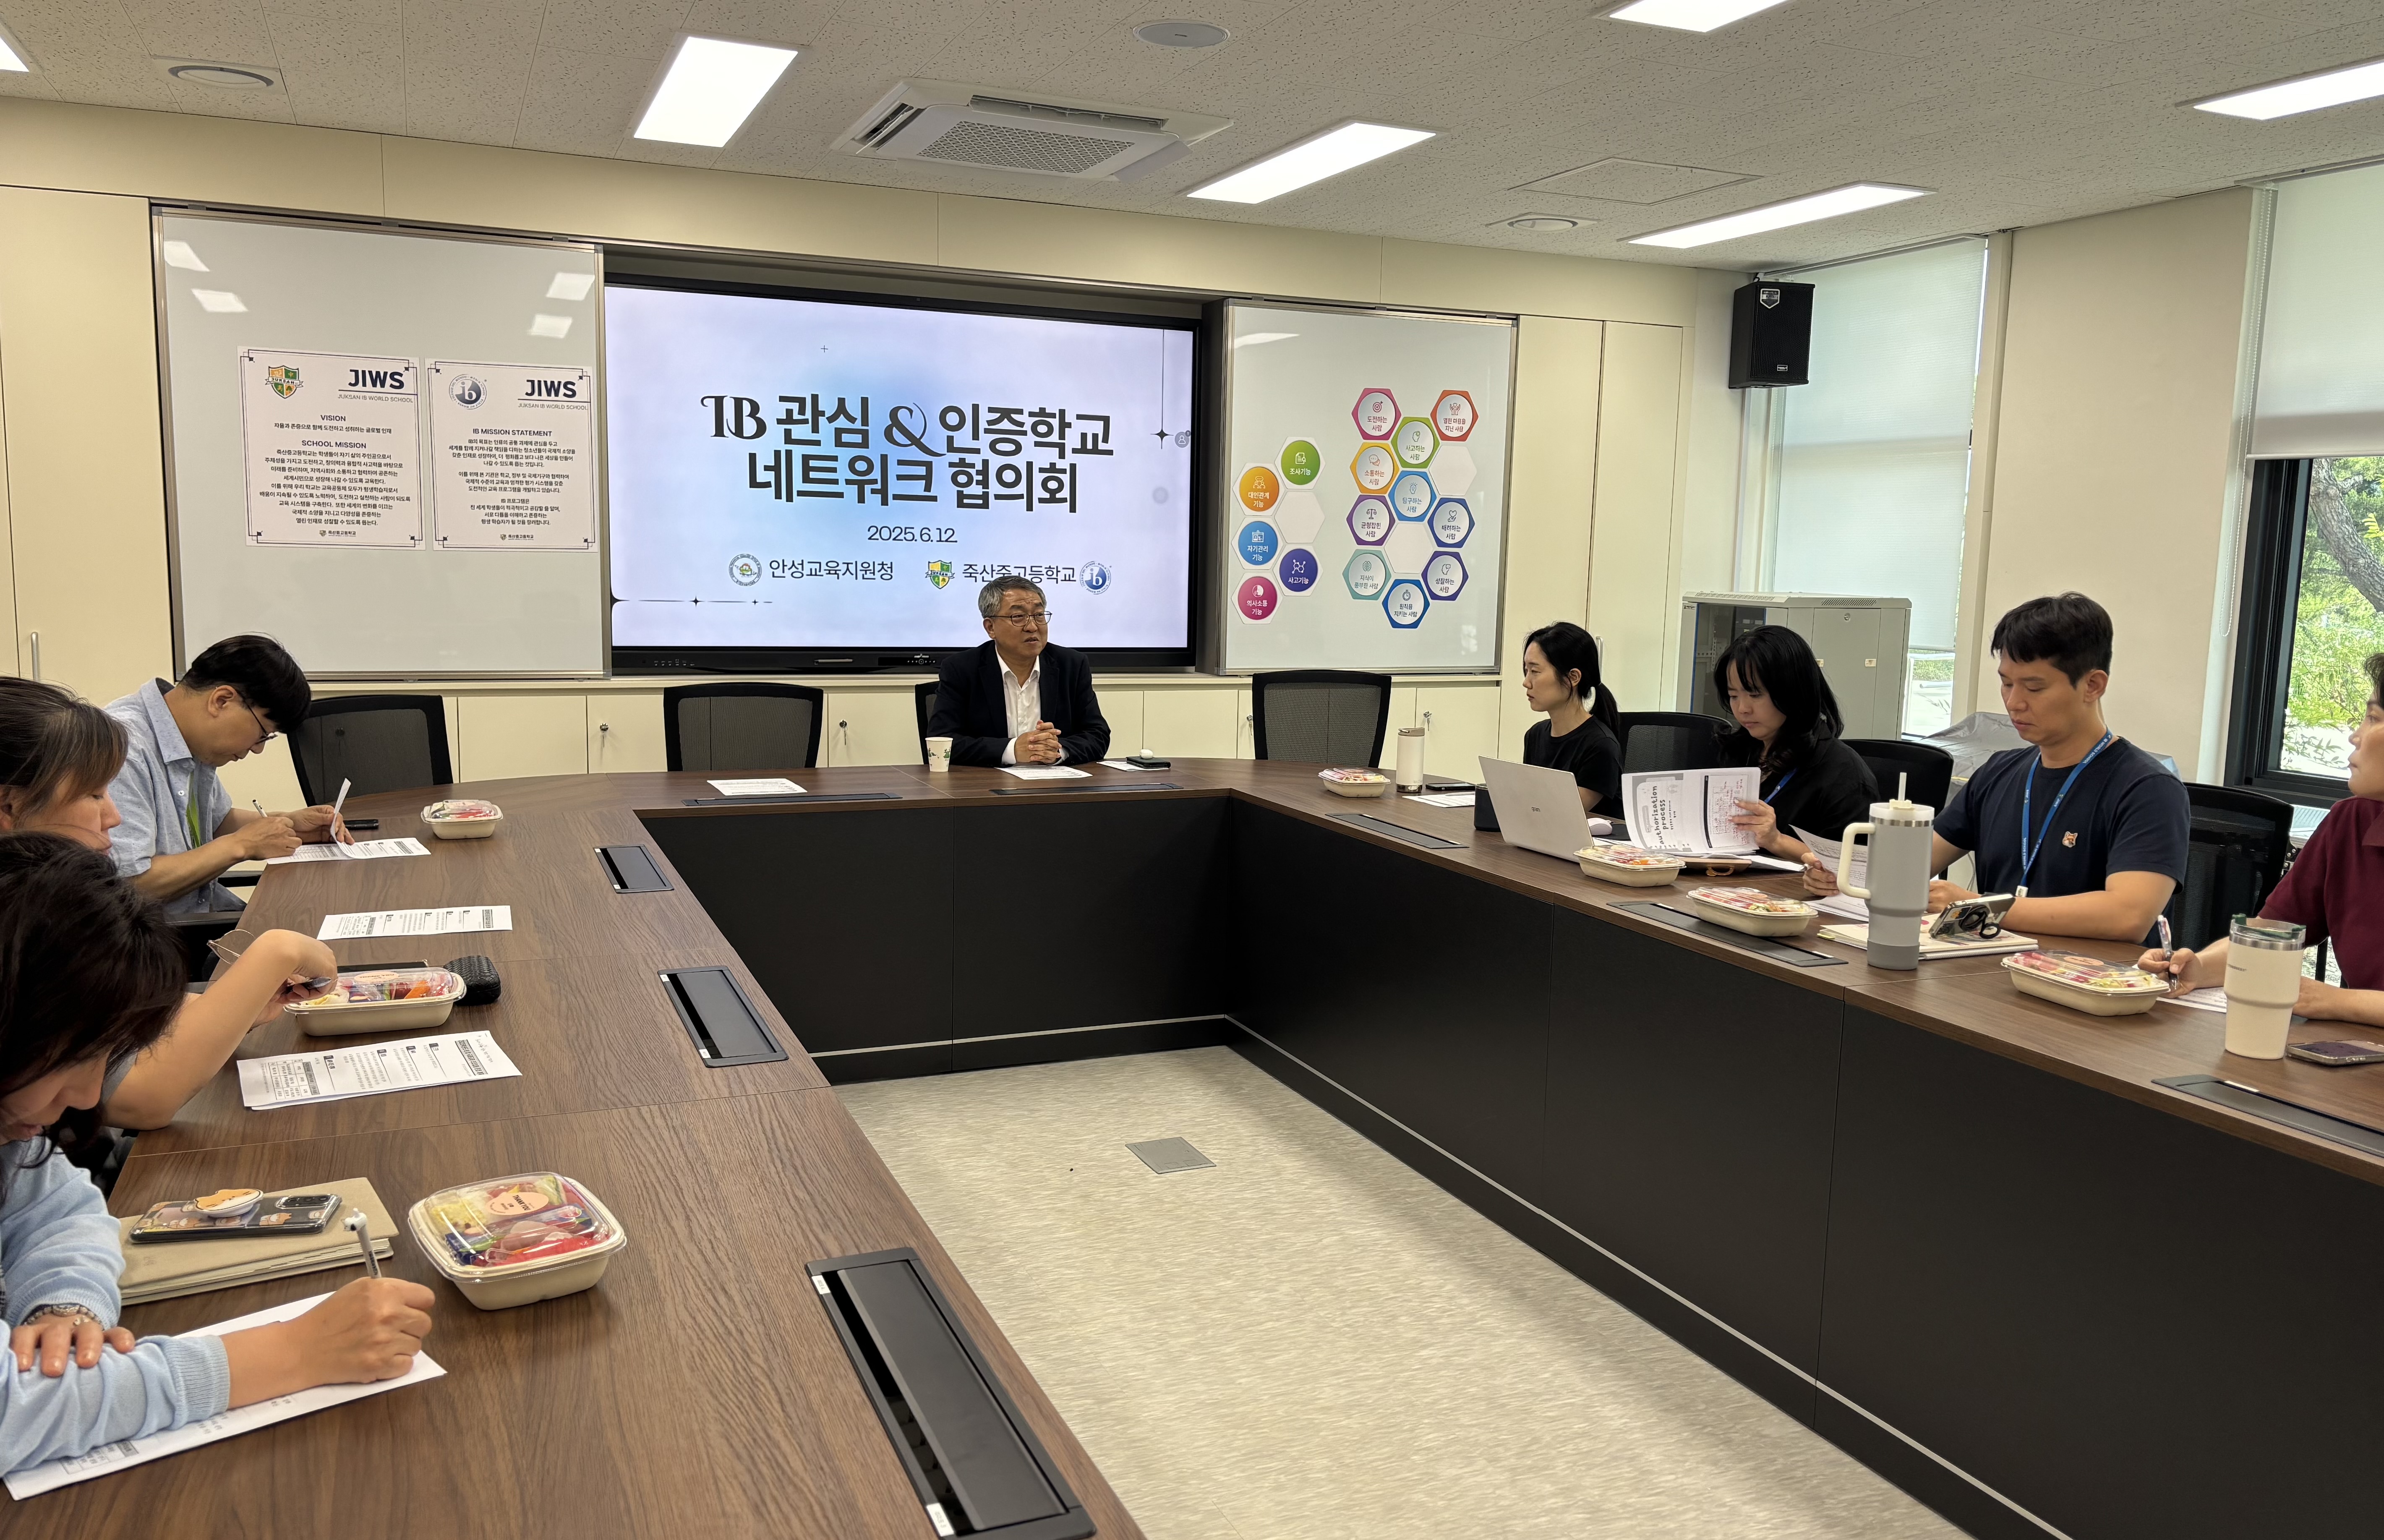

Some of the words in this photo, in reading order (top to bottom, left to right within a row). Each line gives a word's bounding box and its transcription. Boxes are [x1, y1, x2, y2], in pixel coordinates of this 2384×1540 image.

[348, 369, 405, 390] JIWS
[525, 379, 577, 398] JIWS
[701, 395, 767, 440] IB
[776, 394, 870, 449] 관심
[883, 402, 946, 457] &
[939, 403, 1114, 459] 인증학교
[748, 449, 938, 506] 네트워크
[948, 457, 1076, 513] 협의회
[769, 559, 893, 581] 안성교육지원청
[1651, 786, 1664, 844] authorization
[1660, 799, 1669, 830] process
